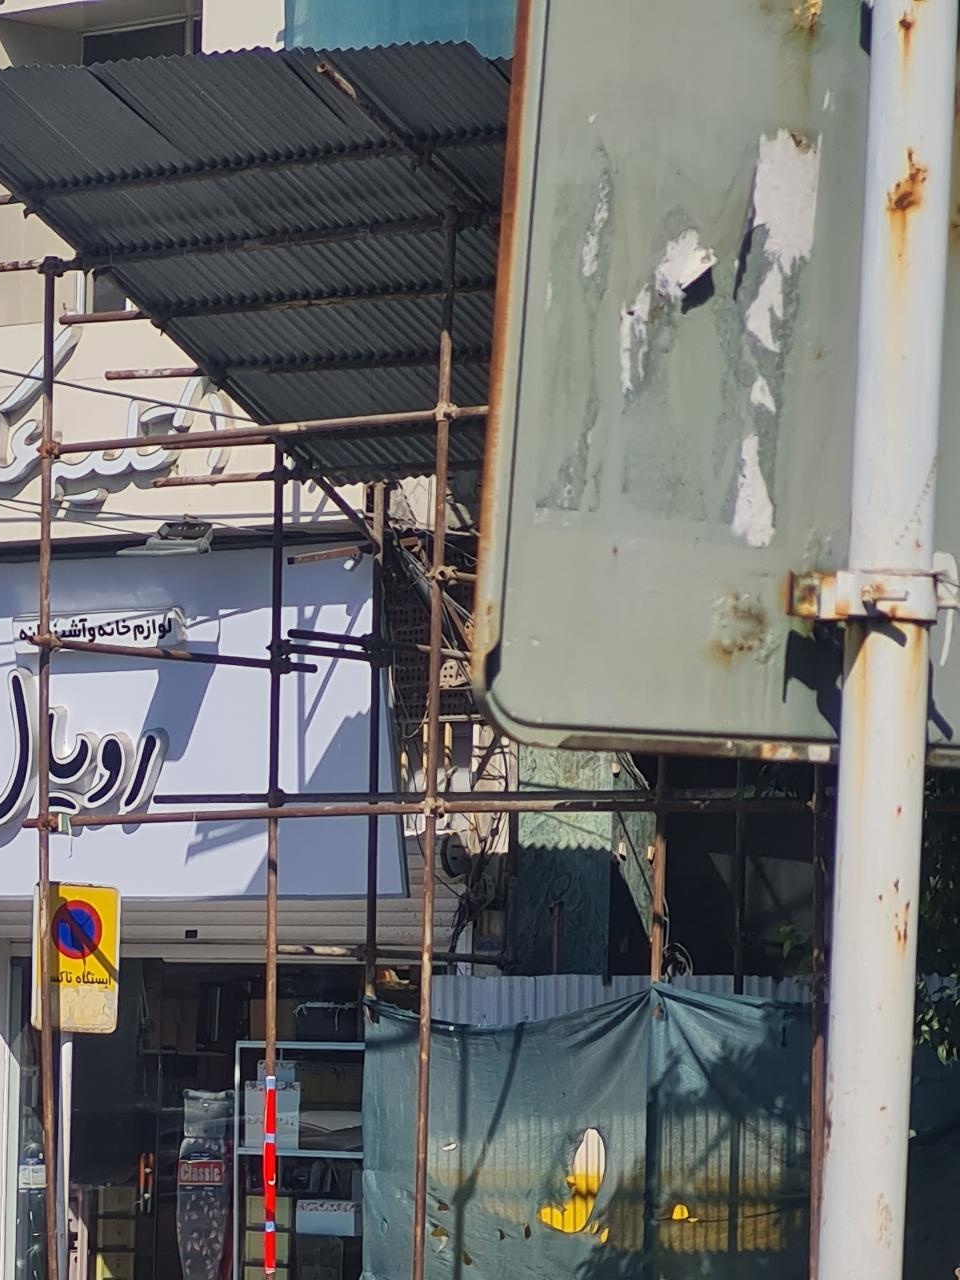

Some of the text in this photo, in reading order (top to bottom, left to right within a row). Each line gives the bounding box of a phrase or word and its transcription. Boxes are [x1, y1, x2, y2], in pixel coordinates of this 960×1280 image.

[98, 619, 132, 636] خانه
[133, 617, 172, 641] لوازم
[49, 971, 111, 989] ایستگاه تاکس
[180, 1163, 221, 1182] Classic
